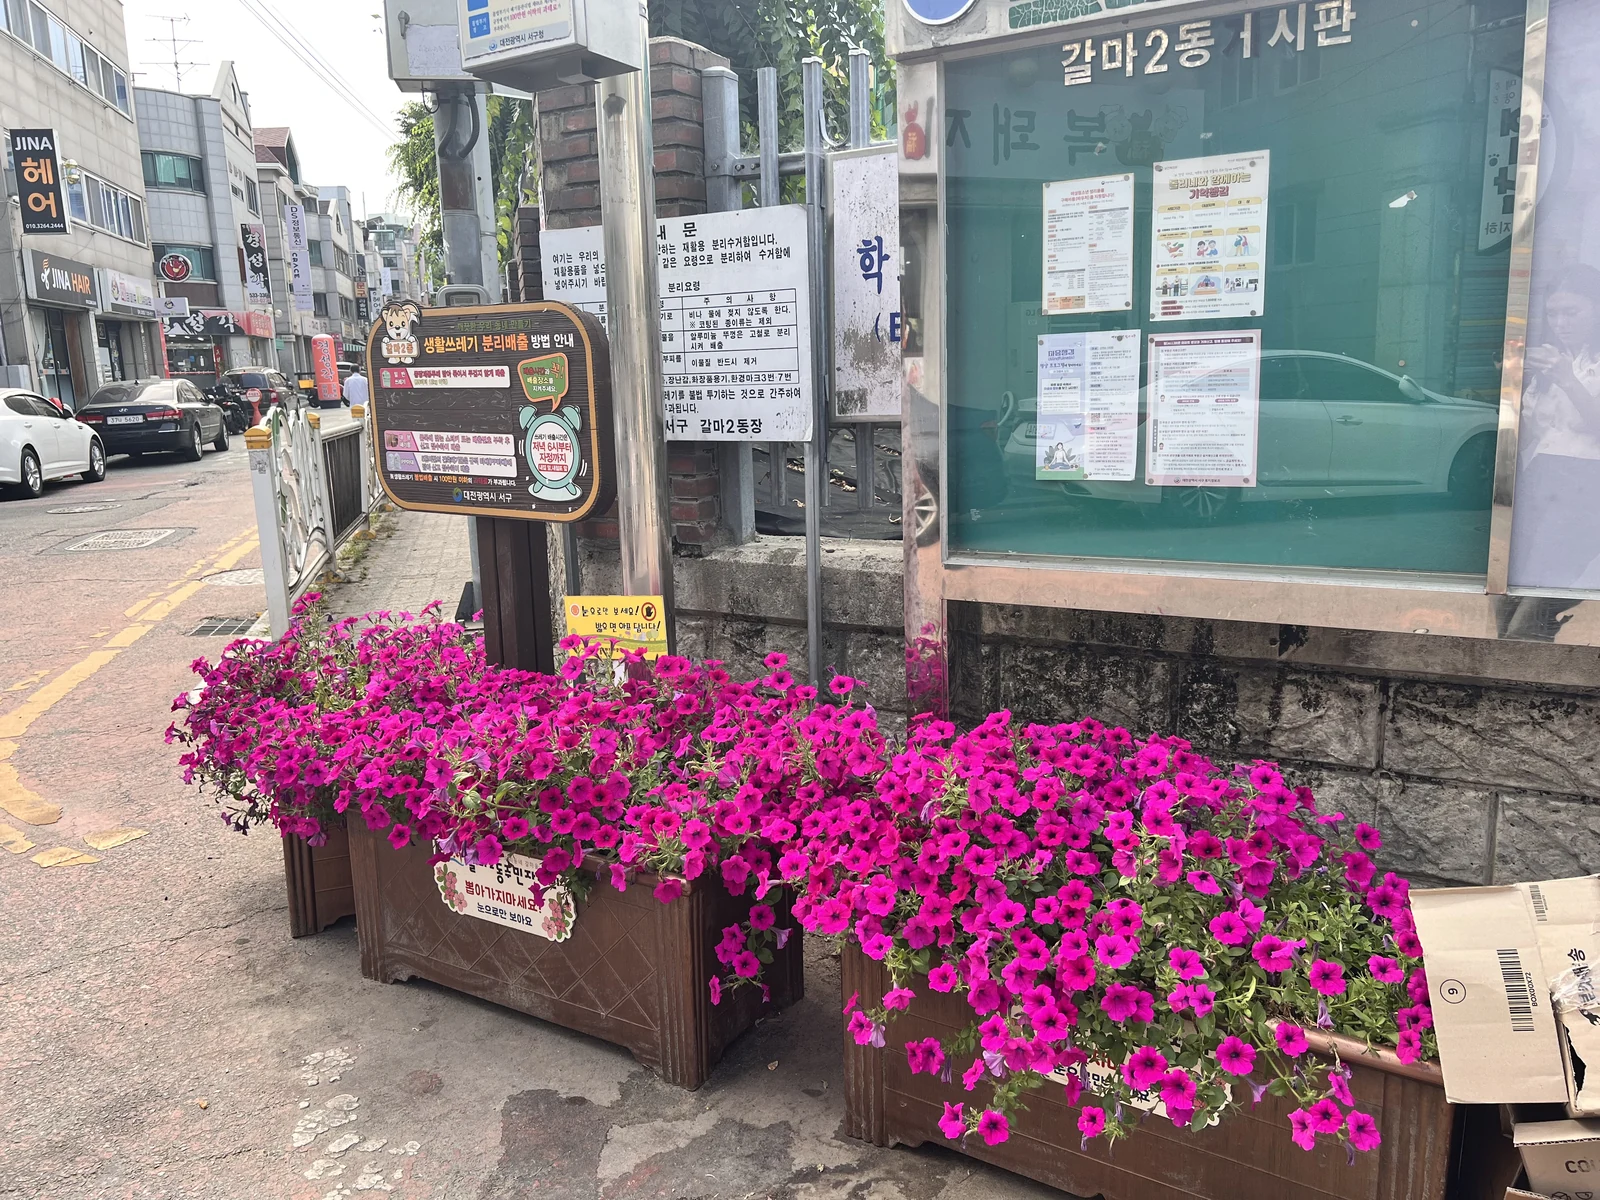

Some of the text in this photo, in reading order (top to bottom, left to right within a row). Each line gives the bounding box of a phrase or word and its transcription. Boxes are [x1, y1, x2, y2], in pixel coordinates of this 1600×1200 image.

[500, 30, 544, 46] 대전광역시 서구청
[15, 137, 52, 151] JINA
[683, 222, 697, 238] 문
[552, 233, 778, 264] 여기는 우리의 하는 재활용 분리수거함입니다.
[553, 265, 587, 277] 재활용품을
[662, 256, 677, 269] 같은
[683, 254, 714, 267] 요령으로
[720, 250, 751, 264] 분리하여
[758, 246, 791, 260] 수거함에
[857, 235, 891, 294] 학
[52, 267, 71, 291] JINA
[71, 272, 91, 295] HAIR
[554, 278, 588, 291] 넣어주시기
[668, 280, 701, 293] 분리요령
[688, 310, 702, 319] 비나
[708, 308, 721, 318] 물에
[727, 307, 741, 317] 젖지
[747, 306, 768, 317] 않도록
[774, 305, 791, 315] 한다.
[699, 319, 719, 328] 코팅된
[725, 317, 752, 328] 종이류는
[758, 316, 772, 326] 제외
[690, 331, 717, 341] 알루미늄
[749, 329, 771, 338] 고철로
[777, 327, 790, 337] 분리
[424, 333, 574, 354] 생활쓰레기 분리배출 방법 안내
[710, 341, 724, 350] 배출
[663, 354, 757, 367] 부피를 이물질 반드시 제거
[689, 389, 703, 400] 불법
[706, 388, 735, 400] 투기하는
[740, 388, 765, 399] 것으로
[769, 387, 801, 399] 간주하여
[700, 418, 762, 434] 갈마2동장
[533, 442, 572, 453] 저녁 6시부터
[539, 452, 567, 464] 자정까지
[463, 490, 512, 503] 대전광역시 서구
[582, 605, 640, 617] 눈으로만 보세요!
[595, 622, 617, 633] 밟으면
[477, 902, 533, 927] 눈으로만 보아요
